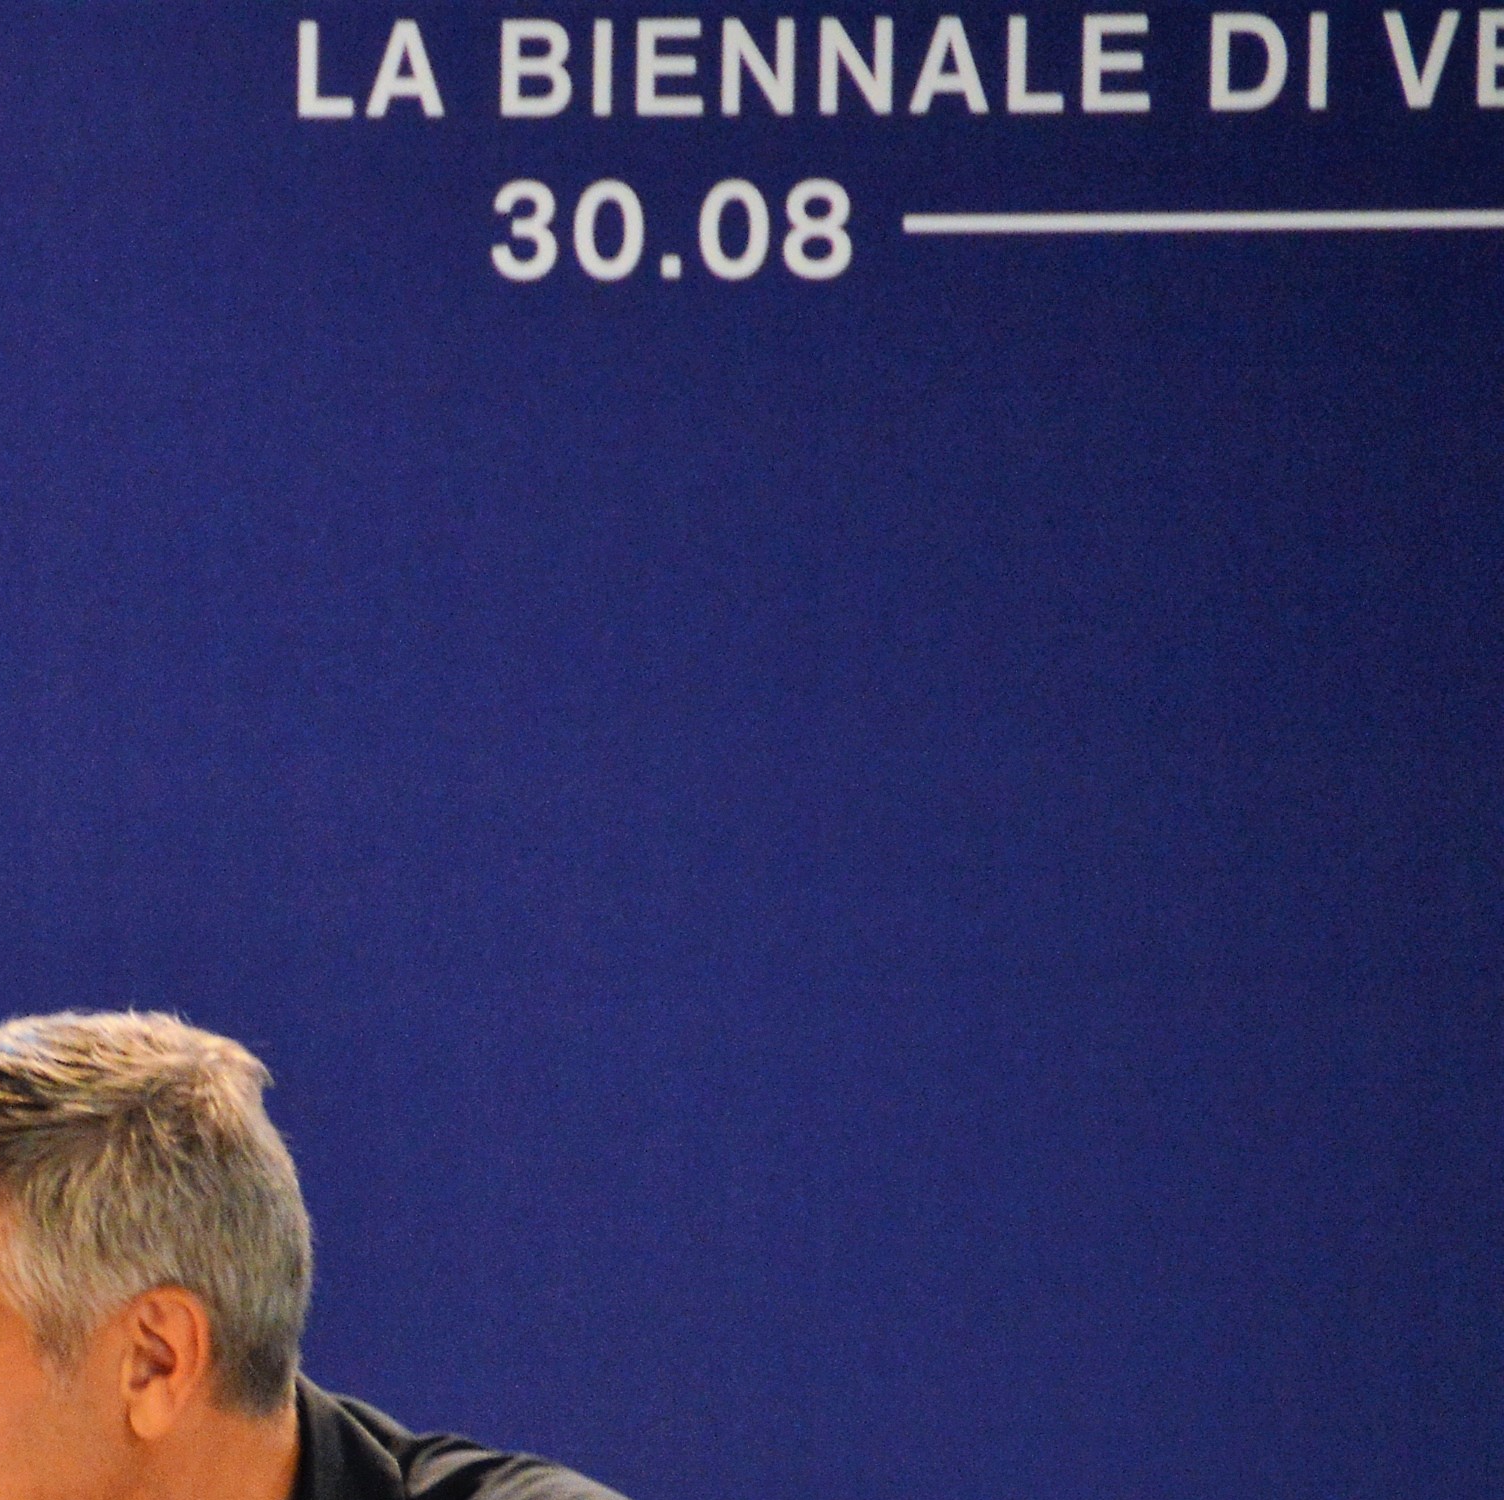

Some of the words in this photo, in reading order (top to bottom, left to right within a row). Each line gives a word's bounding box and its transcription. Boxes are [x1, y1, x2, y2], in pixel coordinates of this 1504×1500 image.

[296, 18, 447, 120] LA
[499, 14, 1152, 119] BIENNALE
[1208, 11, 1330, 113] DI
[490, 178, 853, 283] 30.08
